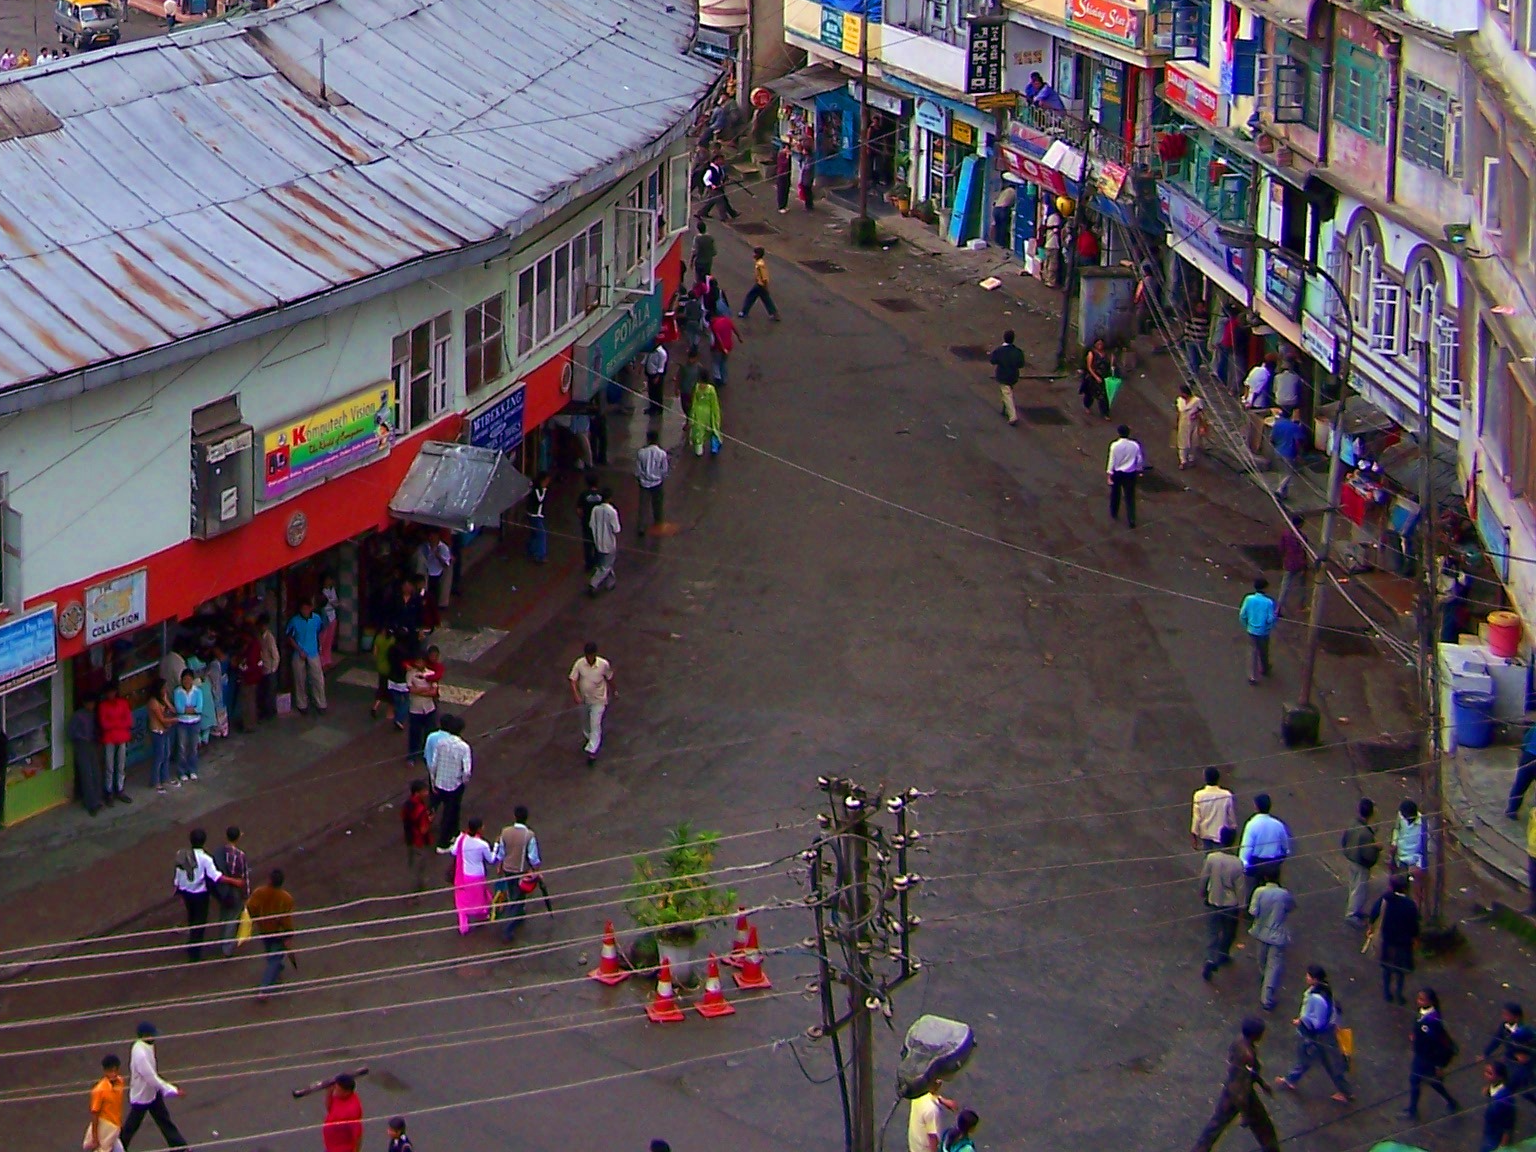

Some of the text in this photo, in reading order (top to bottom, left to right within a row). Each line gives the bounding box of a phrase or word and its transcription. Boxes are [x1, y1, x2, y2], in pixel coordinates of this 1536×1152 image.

[1104, 9, 1127, 28] Star
[292, 403, 375, 446] Komputech Vision
[92, 612, 139, 637] COLLECTION
